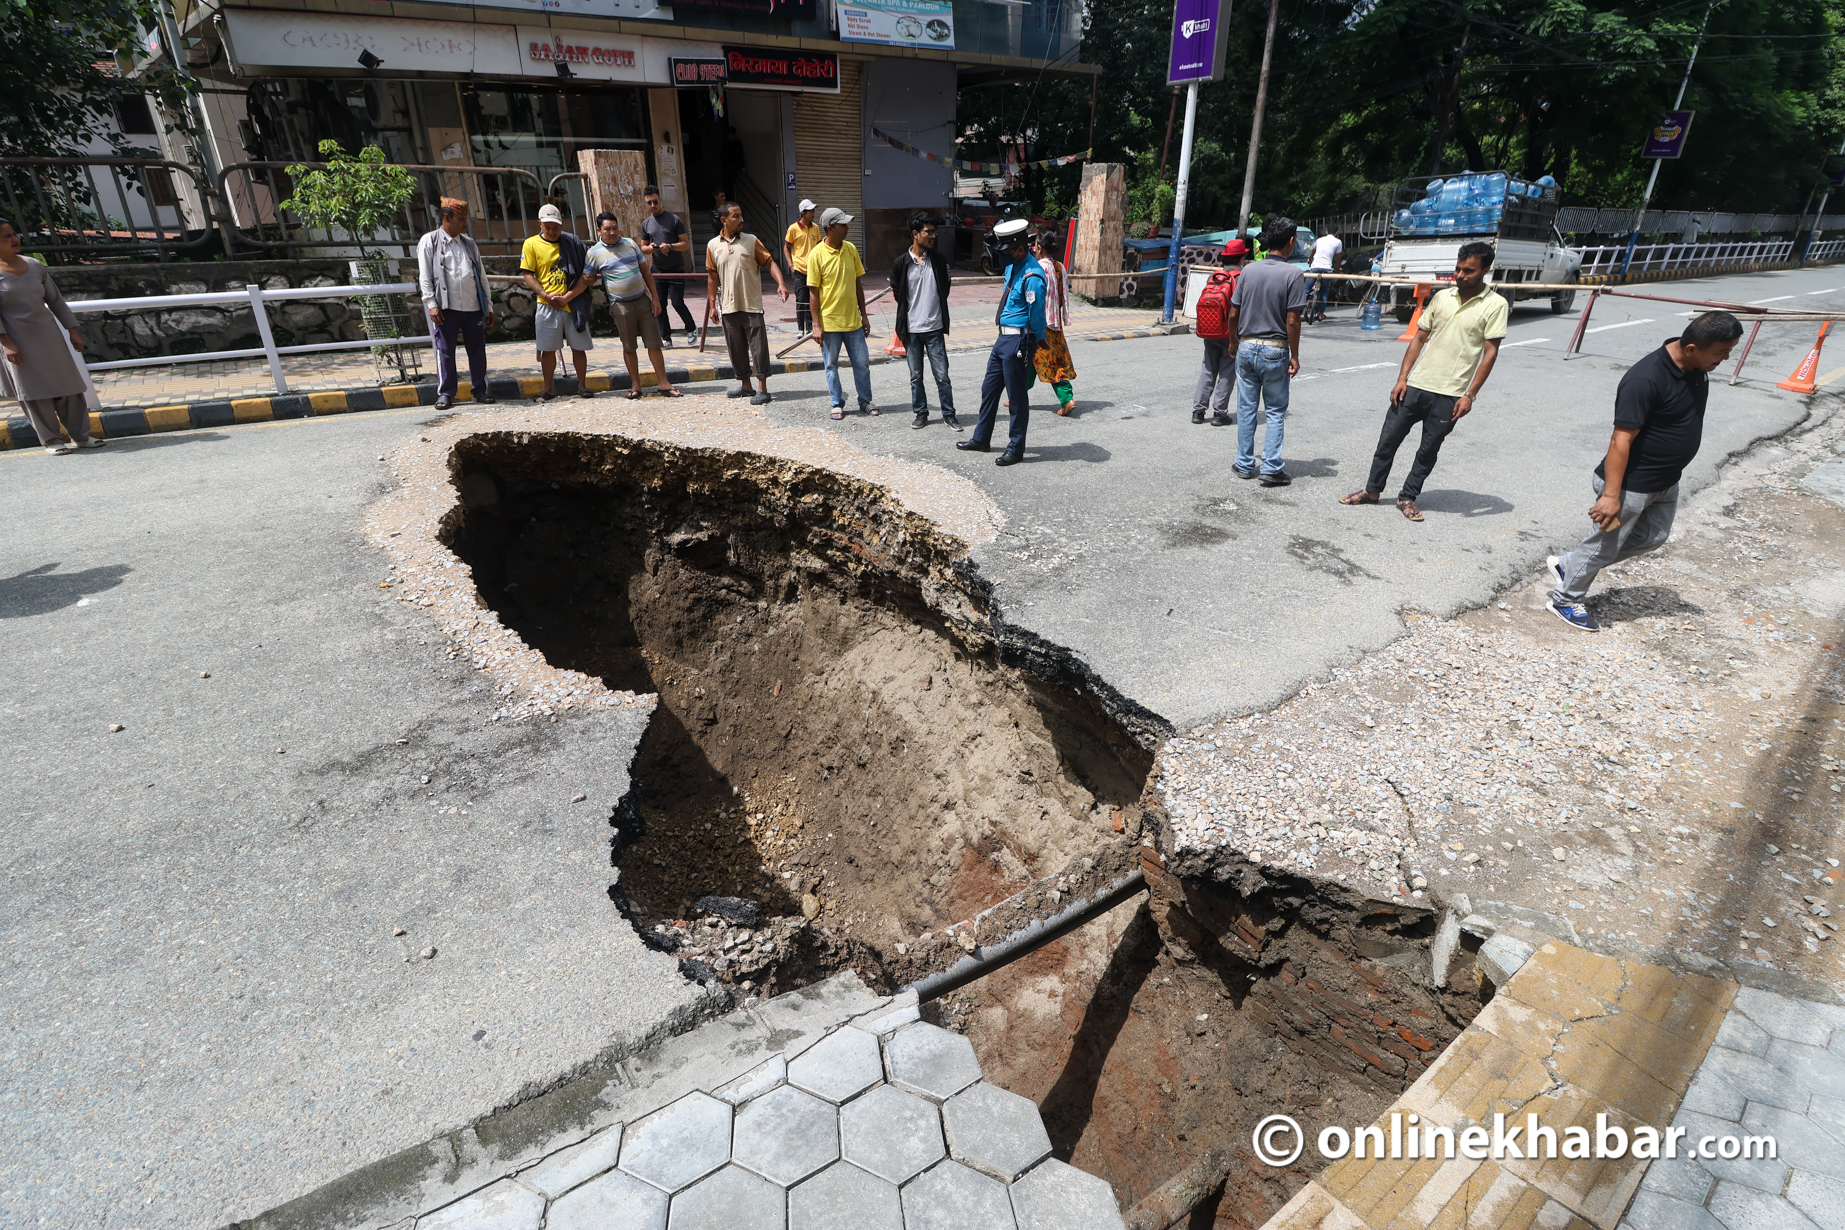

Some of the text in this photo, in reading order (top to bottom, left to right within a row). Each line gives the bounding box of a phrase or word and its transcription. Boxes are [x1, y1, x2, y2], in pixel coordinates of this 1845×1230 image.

[909, 1, 940, 11] PARLOUR
[591, 47, 636, 67] GOTH
[728, 51, 836, 79] निरमाया दोहोरी
[676, 63, 698, 81] CLUB
[788, 174, 795, 182] P
